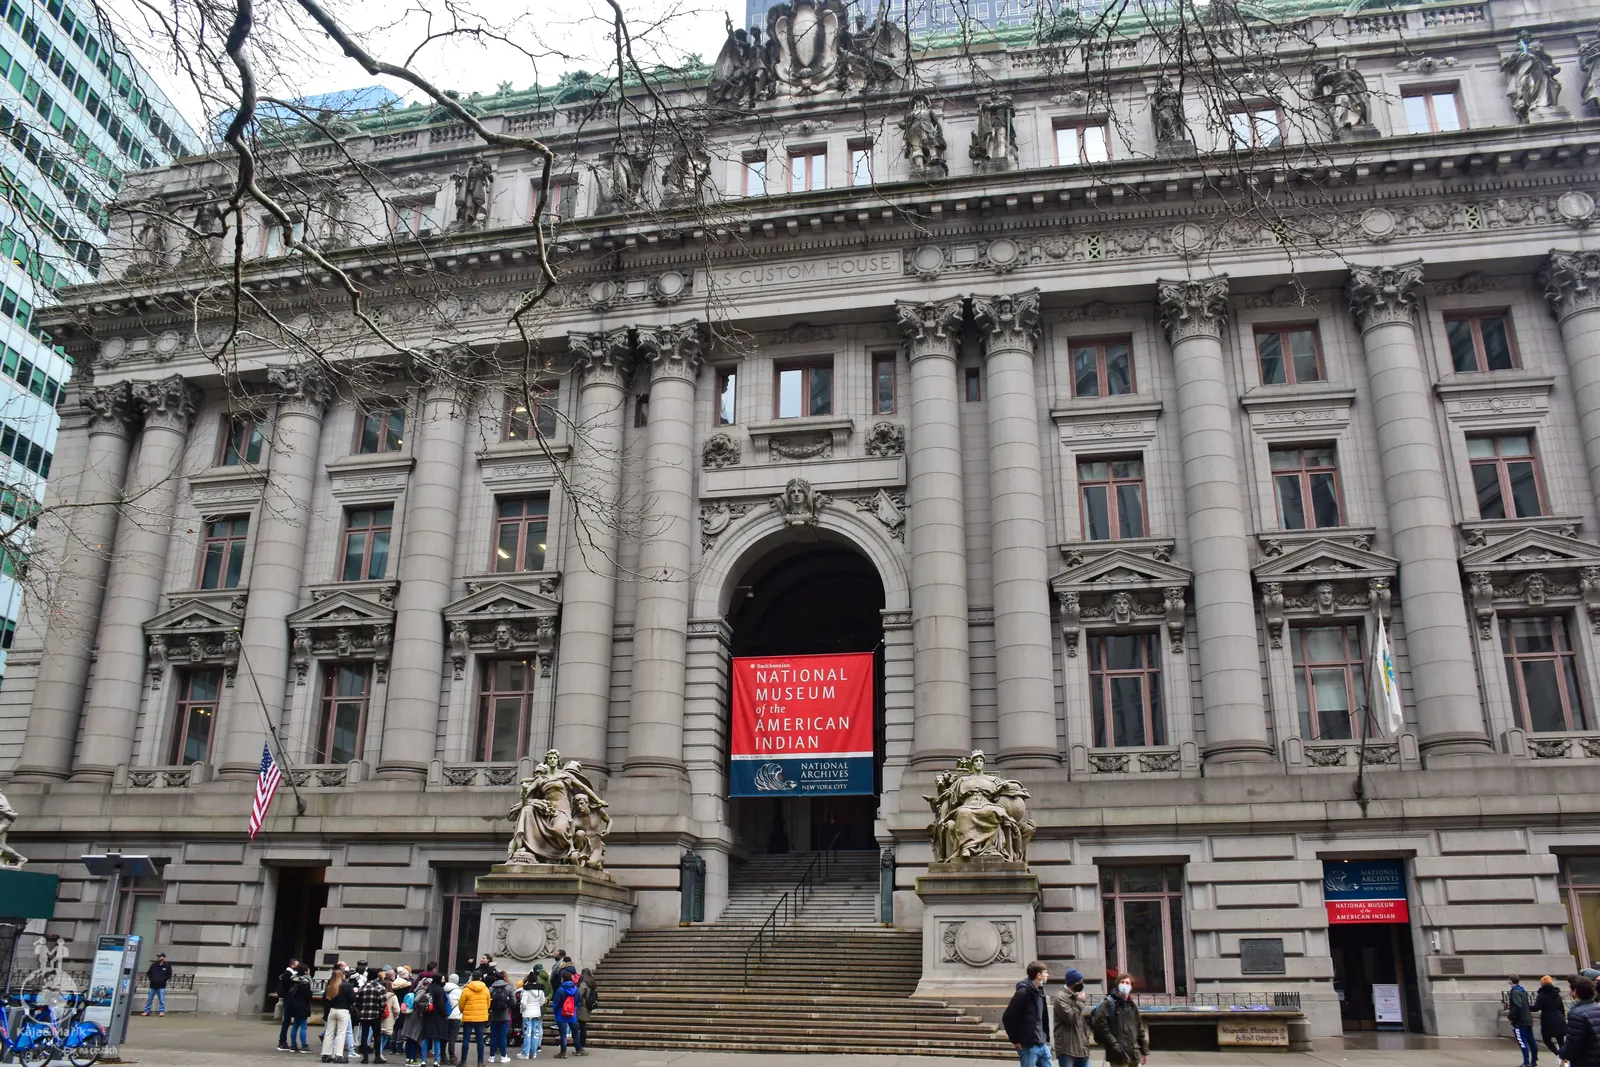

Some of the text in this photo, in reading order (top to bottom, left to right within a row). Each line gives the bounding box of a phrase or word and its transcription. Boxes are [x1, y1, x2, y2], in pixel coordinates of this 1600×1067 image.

[739, 263, 816, 284] CUSTOM
[827, 256, 892, 275] HOUSE
[756, 668, 848, 684] NATIONAL
[756, 686, 835, 701] MUSEUM
[755, 704, 786, 717] of the
[755, 716, 850, 732] AMERICAN
[755, 736, 819, 750] INDIAN
[801, 762, 849, 770] NATIONAL
[800, 770, 849, 778] ARCHIVES
[1255, 1034, 1279, 1042] Groups
